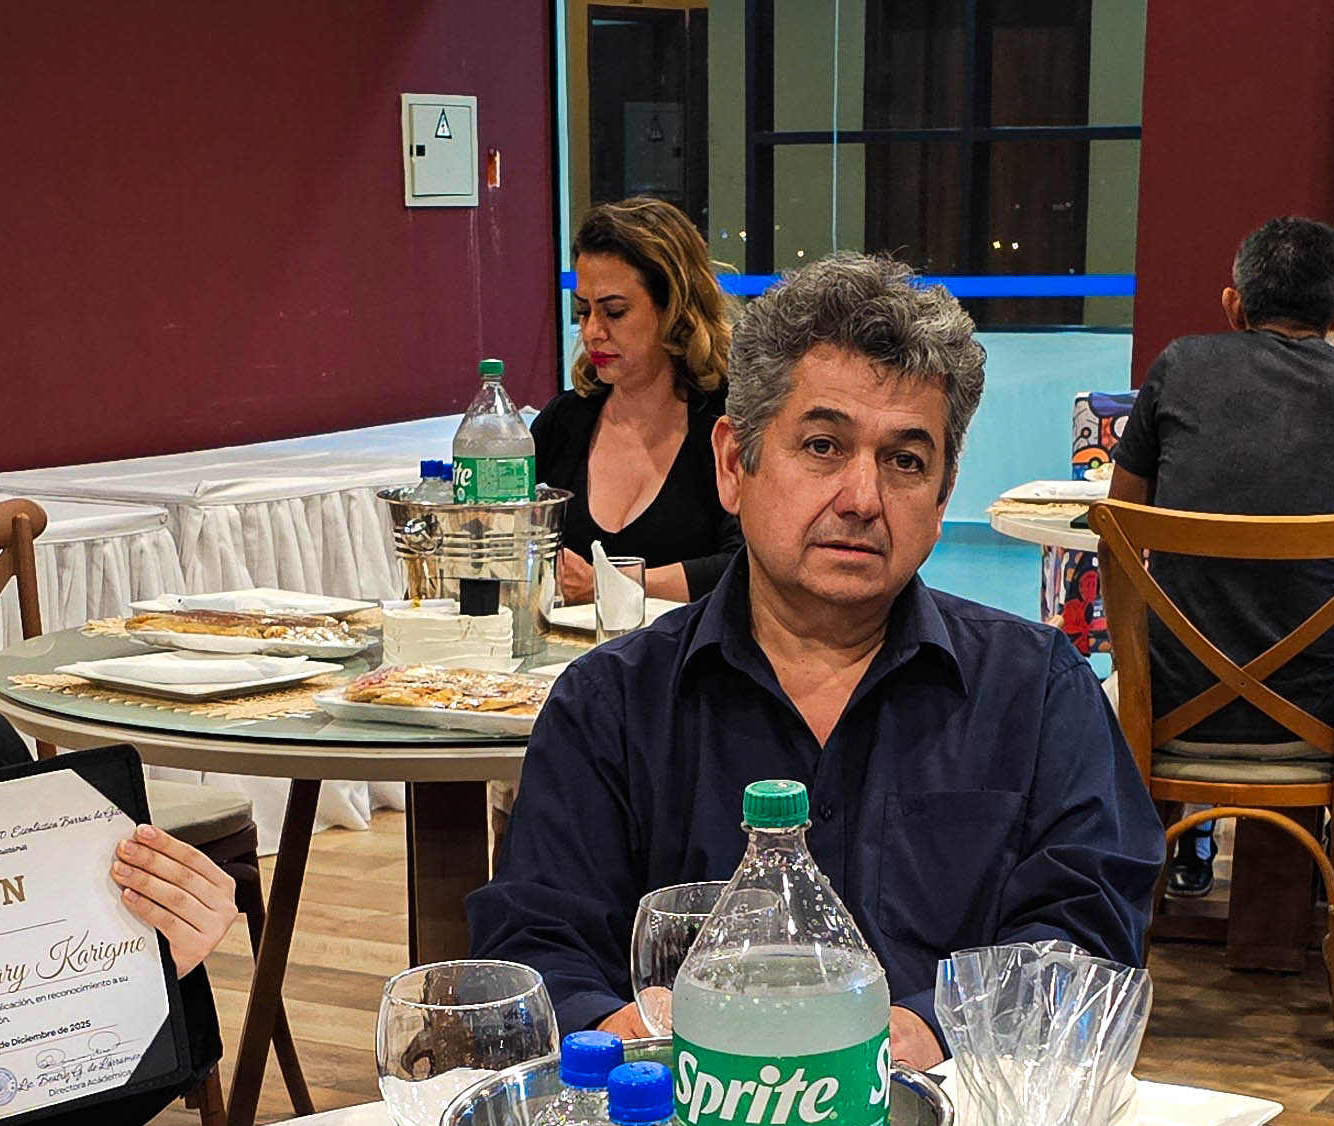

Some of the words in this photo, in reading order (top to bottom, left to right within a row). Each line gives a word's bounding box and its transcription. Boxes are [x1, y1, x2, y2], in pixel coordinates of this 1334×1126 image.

[35, 994, 47, 1004] en
[47, 978, 112, 1001] reconocimiento
[112, 977, 118, 985] a
[118, 975, 129, 984] su
[11, 1029, 56, 1048] Diciembre
[57, 1026, 69, 1035] de
[69, 1019, 92, 1033] 2025
[48, 1082, 86, 1097] Directora
[675, 1051, 839, 1125] Sprite
